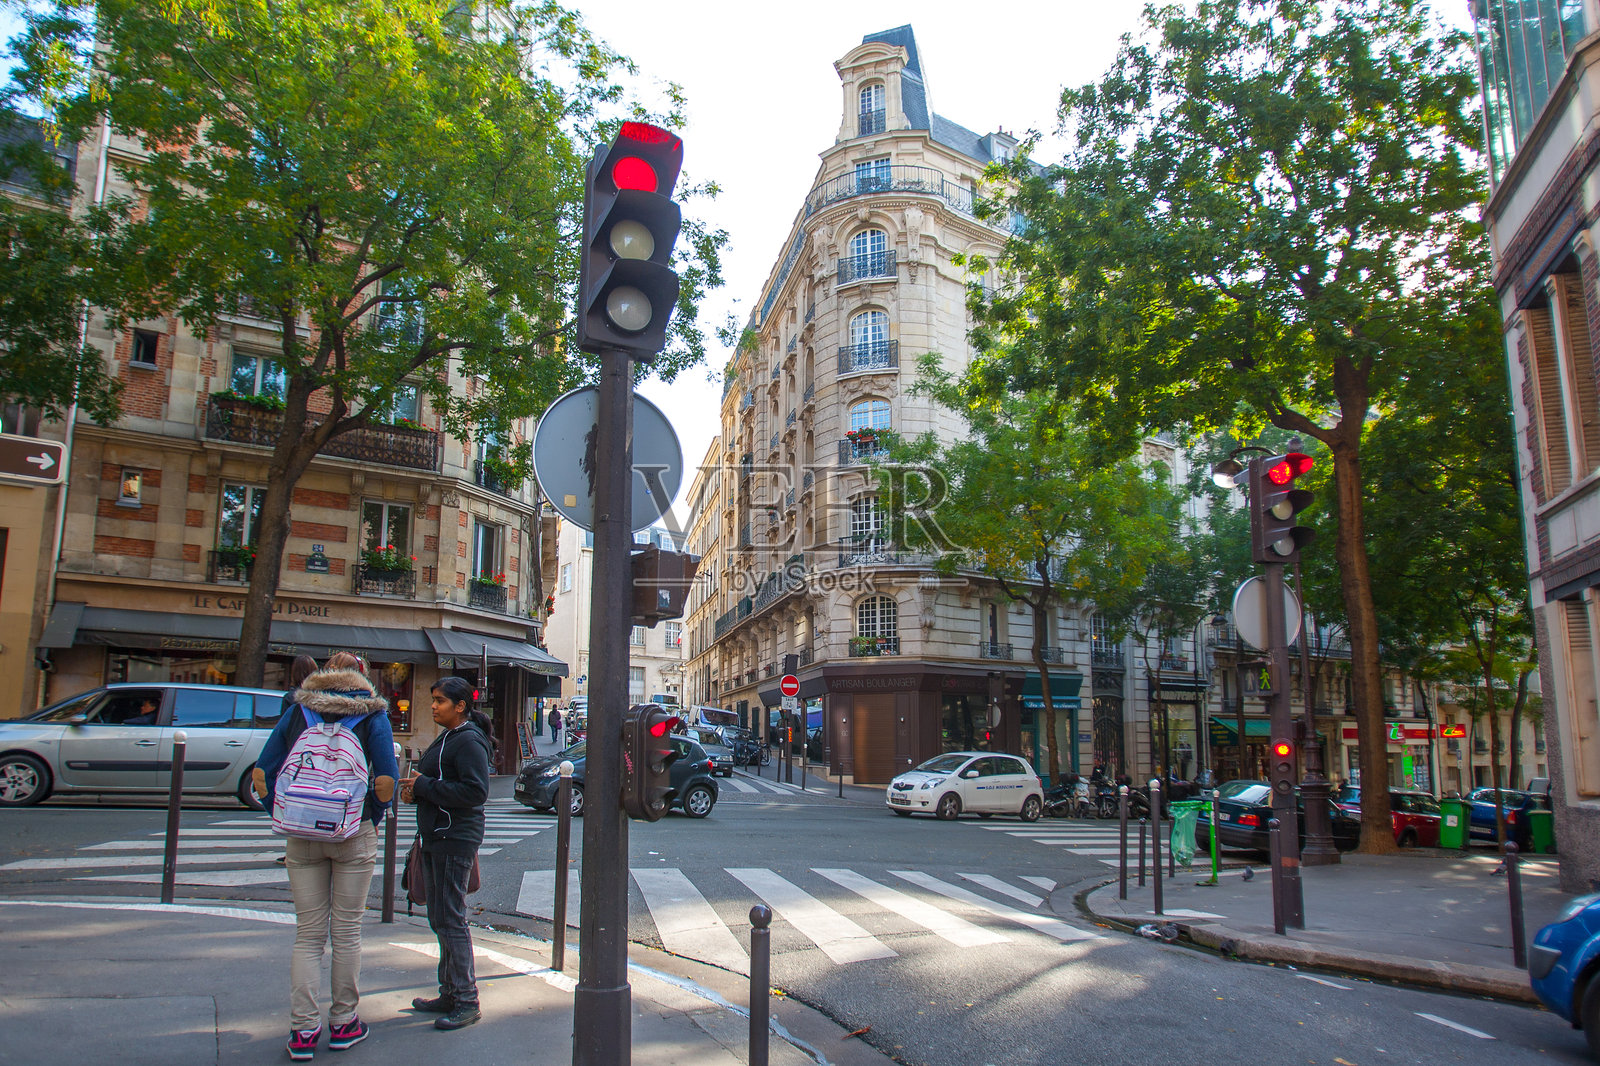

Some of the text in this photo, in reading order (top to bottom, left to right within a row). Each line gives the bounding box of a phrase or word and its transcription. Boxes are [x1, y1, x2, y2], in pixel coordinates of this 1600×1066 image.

[216, 596, 247, 611] CAF
[440, 657, 453, 667] 24
[831, 677, 916, 689] ARTISAN BOULANGER
